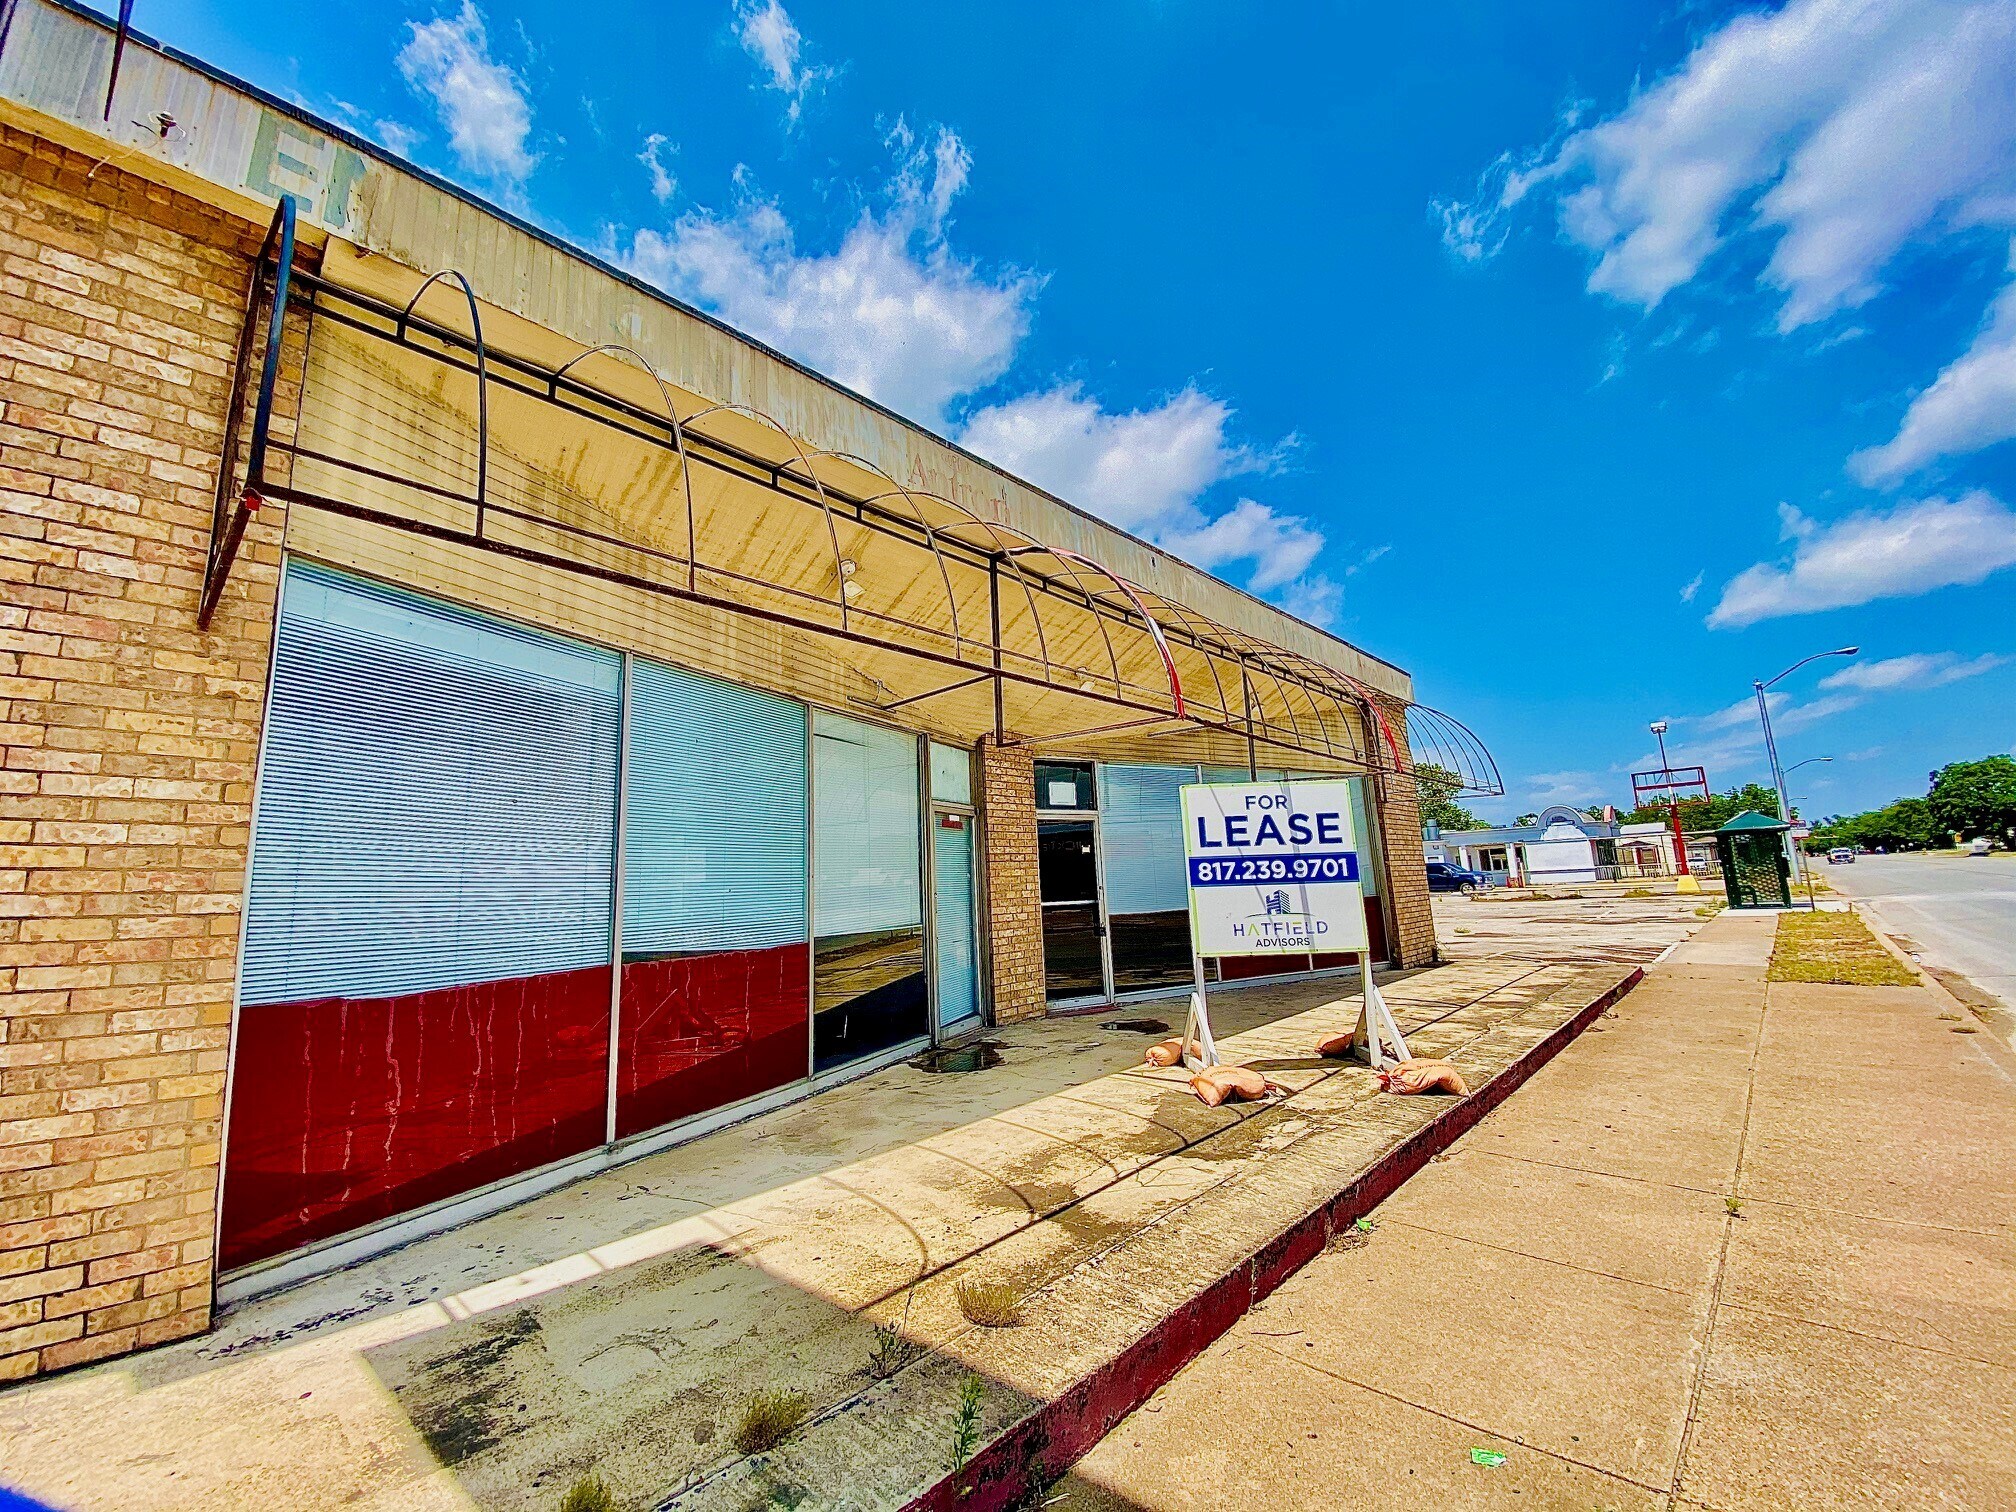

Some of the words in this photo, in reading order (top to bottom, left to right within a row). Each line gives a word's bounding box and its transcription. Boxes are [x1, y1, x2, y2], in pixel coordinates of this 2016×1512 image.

[1245, 794, 1289, 810] FOR
[1197, 812, 1344, 848] LEASE
[1198, 858, 1349, 881] 817.239.9701
[1233, 920, 1329, 937] HATFIELD
[1255, 937, 1311, 948] ADVISORS
